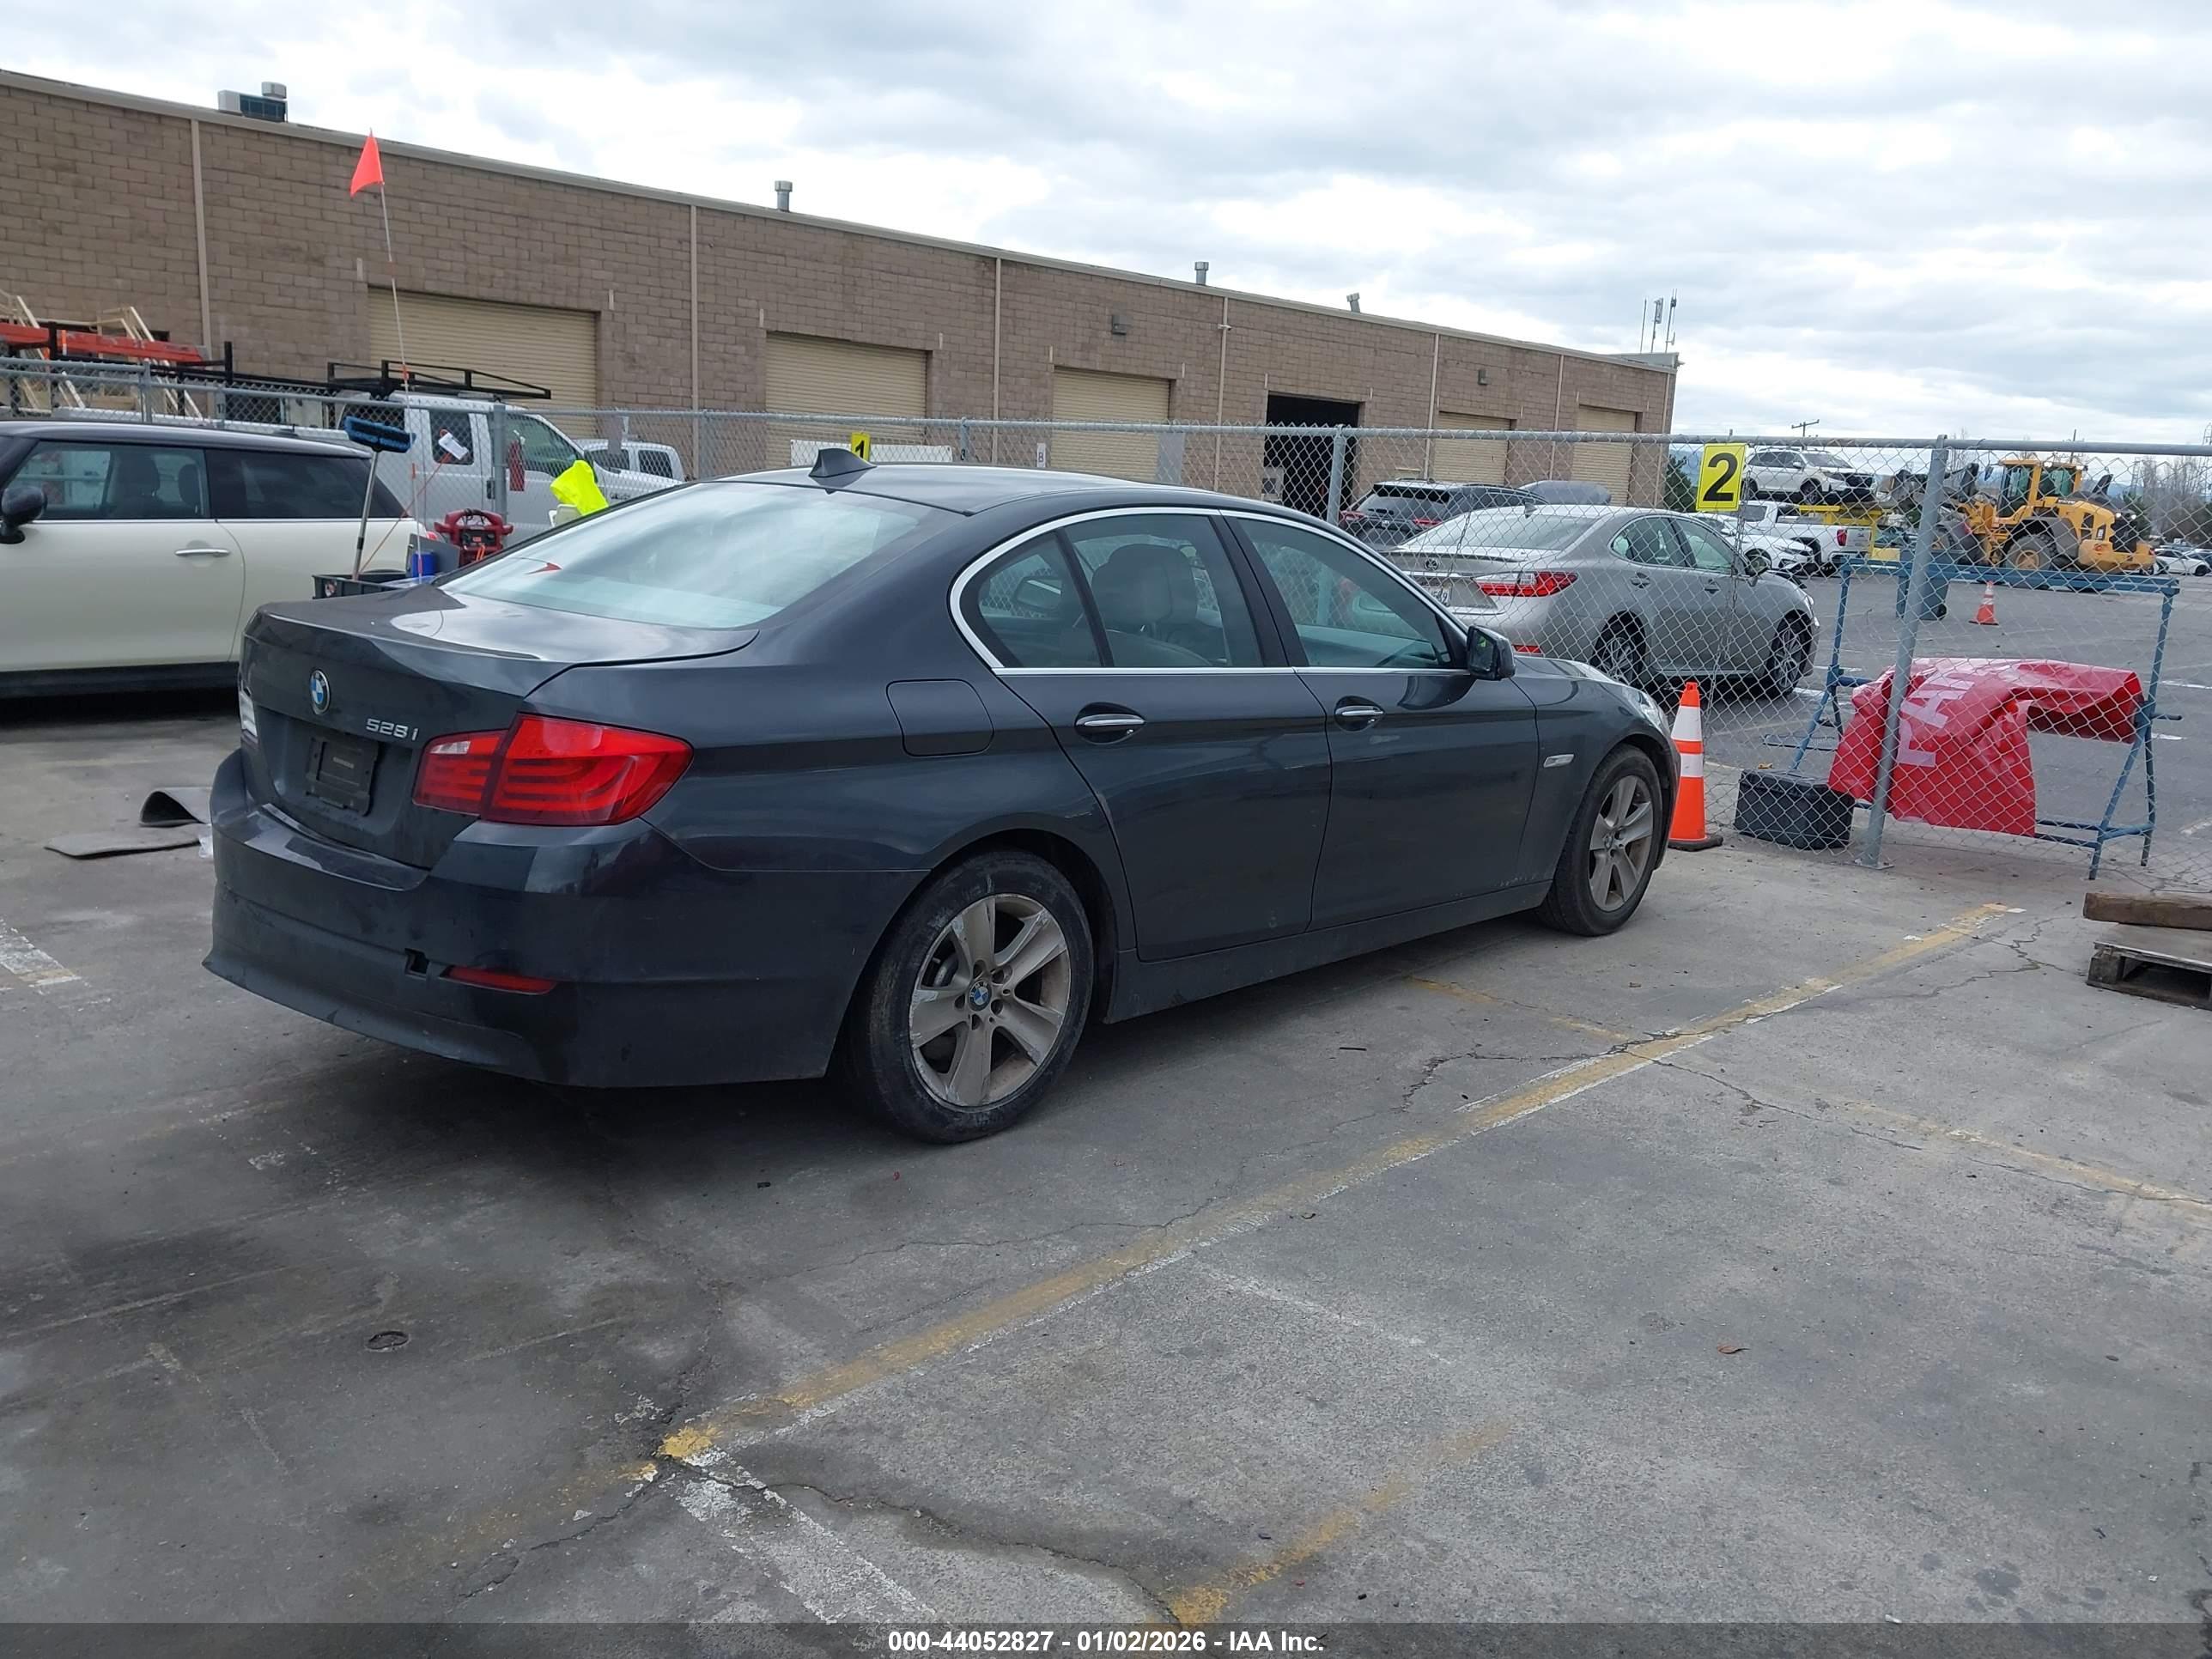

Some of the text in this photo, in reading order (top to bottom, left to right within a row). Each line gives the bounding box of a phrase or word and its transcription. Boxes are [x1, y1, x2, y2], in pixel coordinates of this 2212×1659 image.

[855, 440, 865, 459] 1
[1703, 453, 1738, 501] 2
[366, 718, 419, 741] 528i
